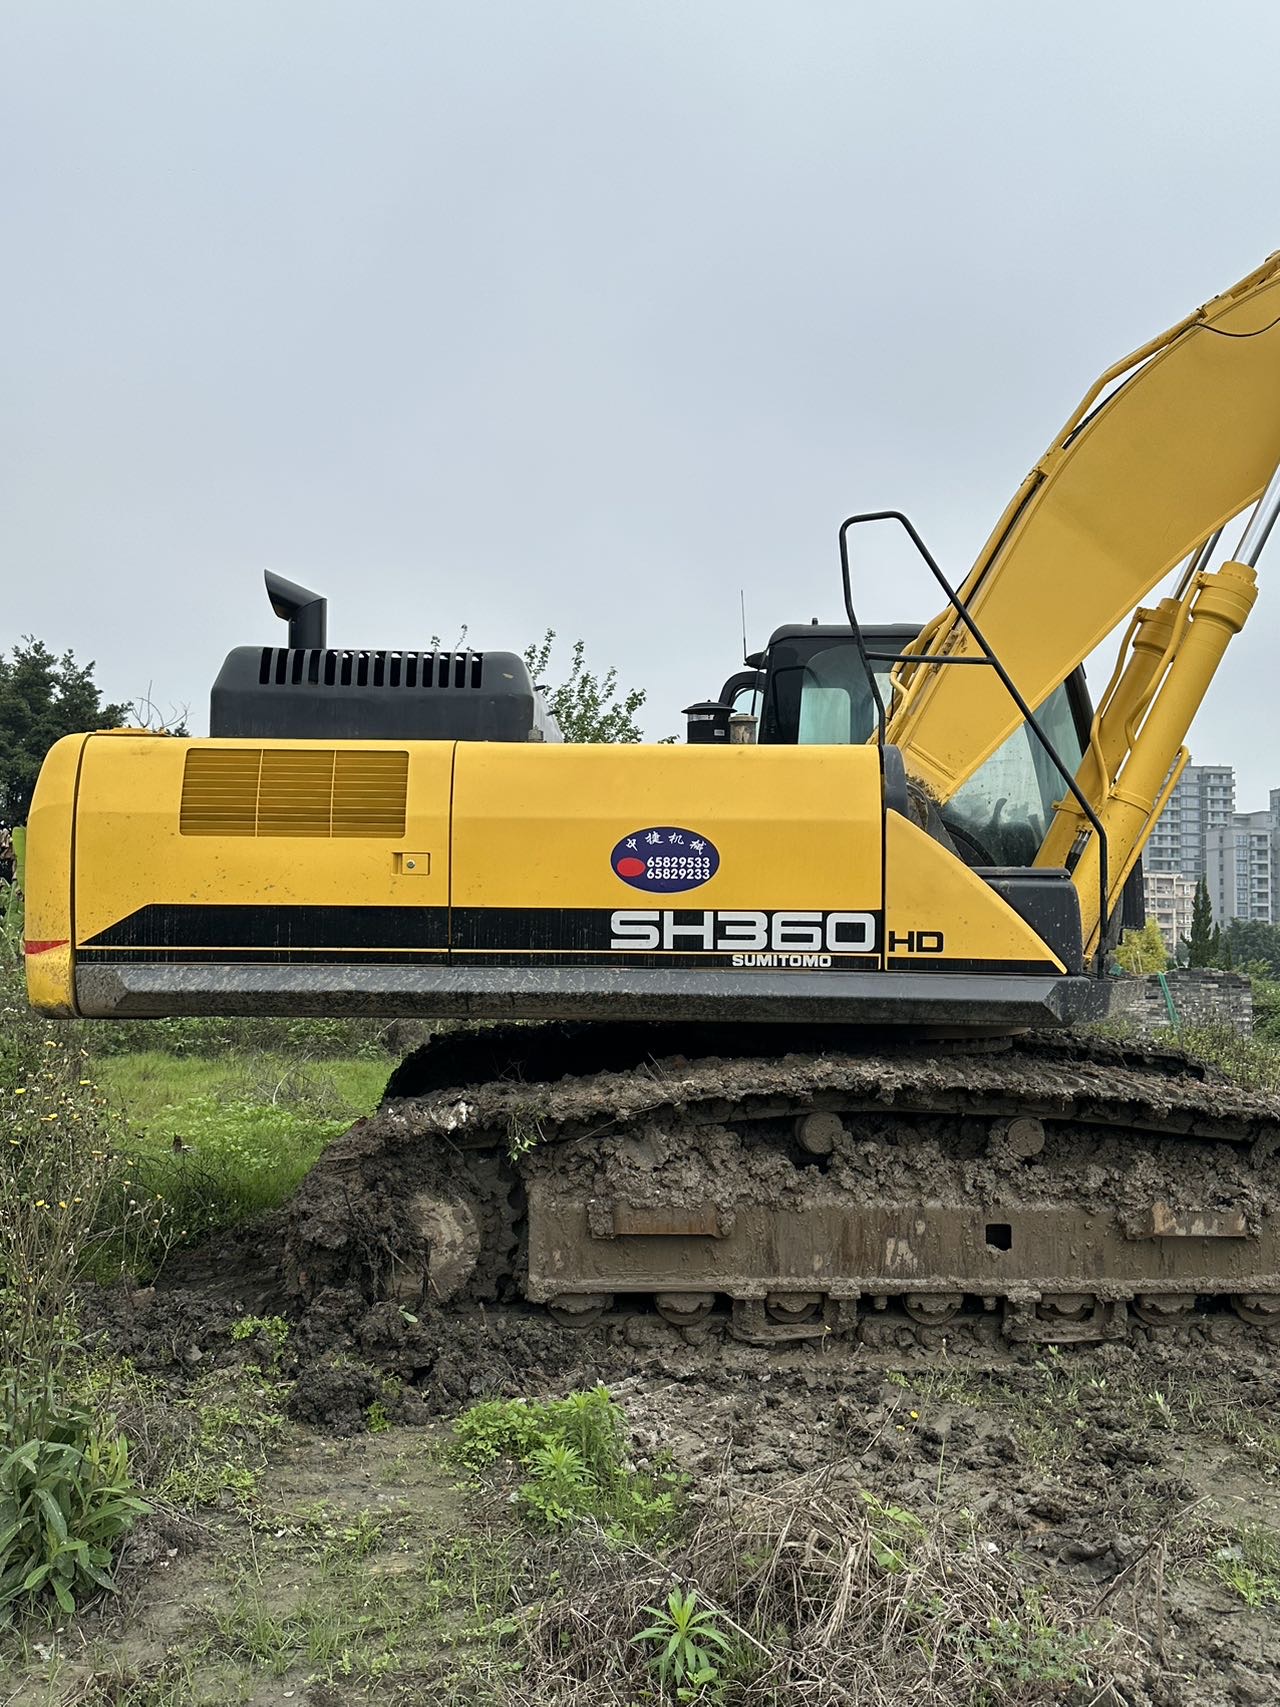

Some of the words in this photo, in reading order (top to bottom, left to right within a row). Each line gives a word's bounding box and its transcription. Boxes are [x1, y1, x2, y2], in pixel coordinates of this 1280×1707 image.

[647, 857, 710, 868] 65829533
[647, 869, 710, 880] 65829233
[610, 911, 876, 952] SH360
[888, 931, 944, 953] HD
[732, 954, 832, 968] SUMITOMO
